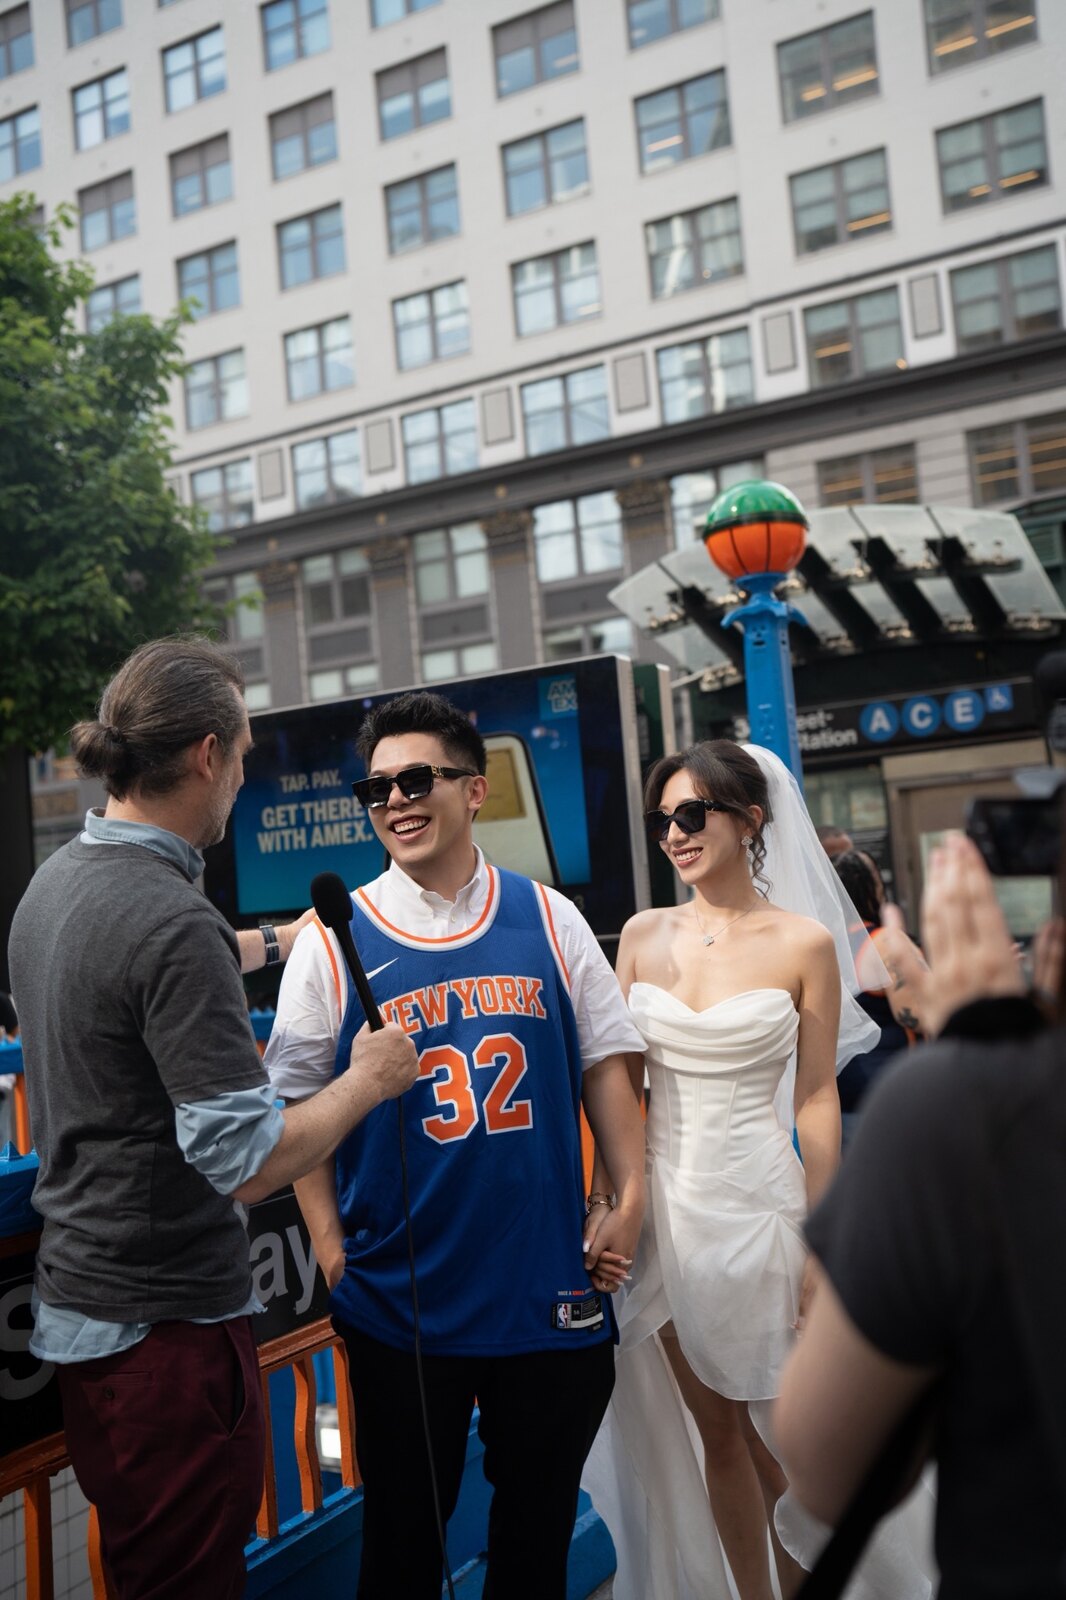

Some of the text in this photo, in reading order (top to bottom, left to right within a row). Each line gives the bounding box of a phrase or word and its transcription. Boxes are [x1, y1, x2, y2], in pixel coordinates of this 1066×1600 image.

[796, 709, 834, 731] eet-
[869, 707, 892, 733] A
[909, 702, 933, 729] C
[953, 697, 975, 724] E
[797, 728, 858, 751] tation
[280, 769, 342, 794] TAP. PAY.
[262, 795, 367, 829] GET THERE
[257, 821, 374, 854] WITH AMEX.
[451, 975, 547, 1020] YORK
[415, 1032, 533, 1145] 32
